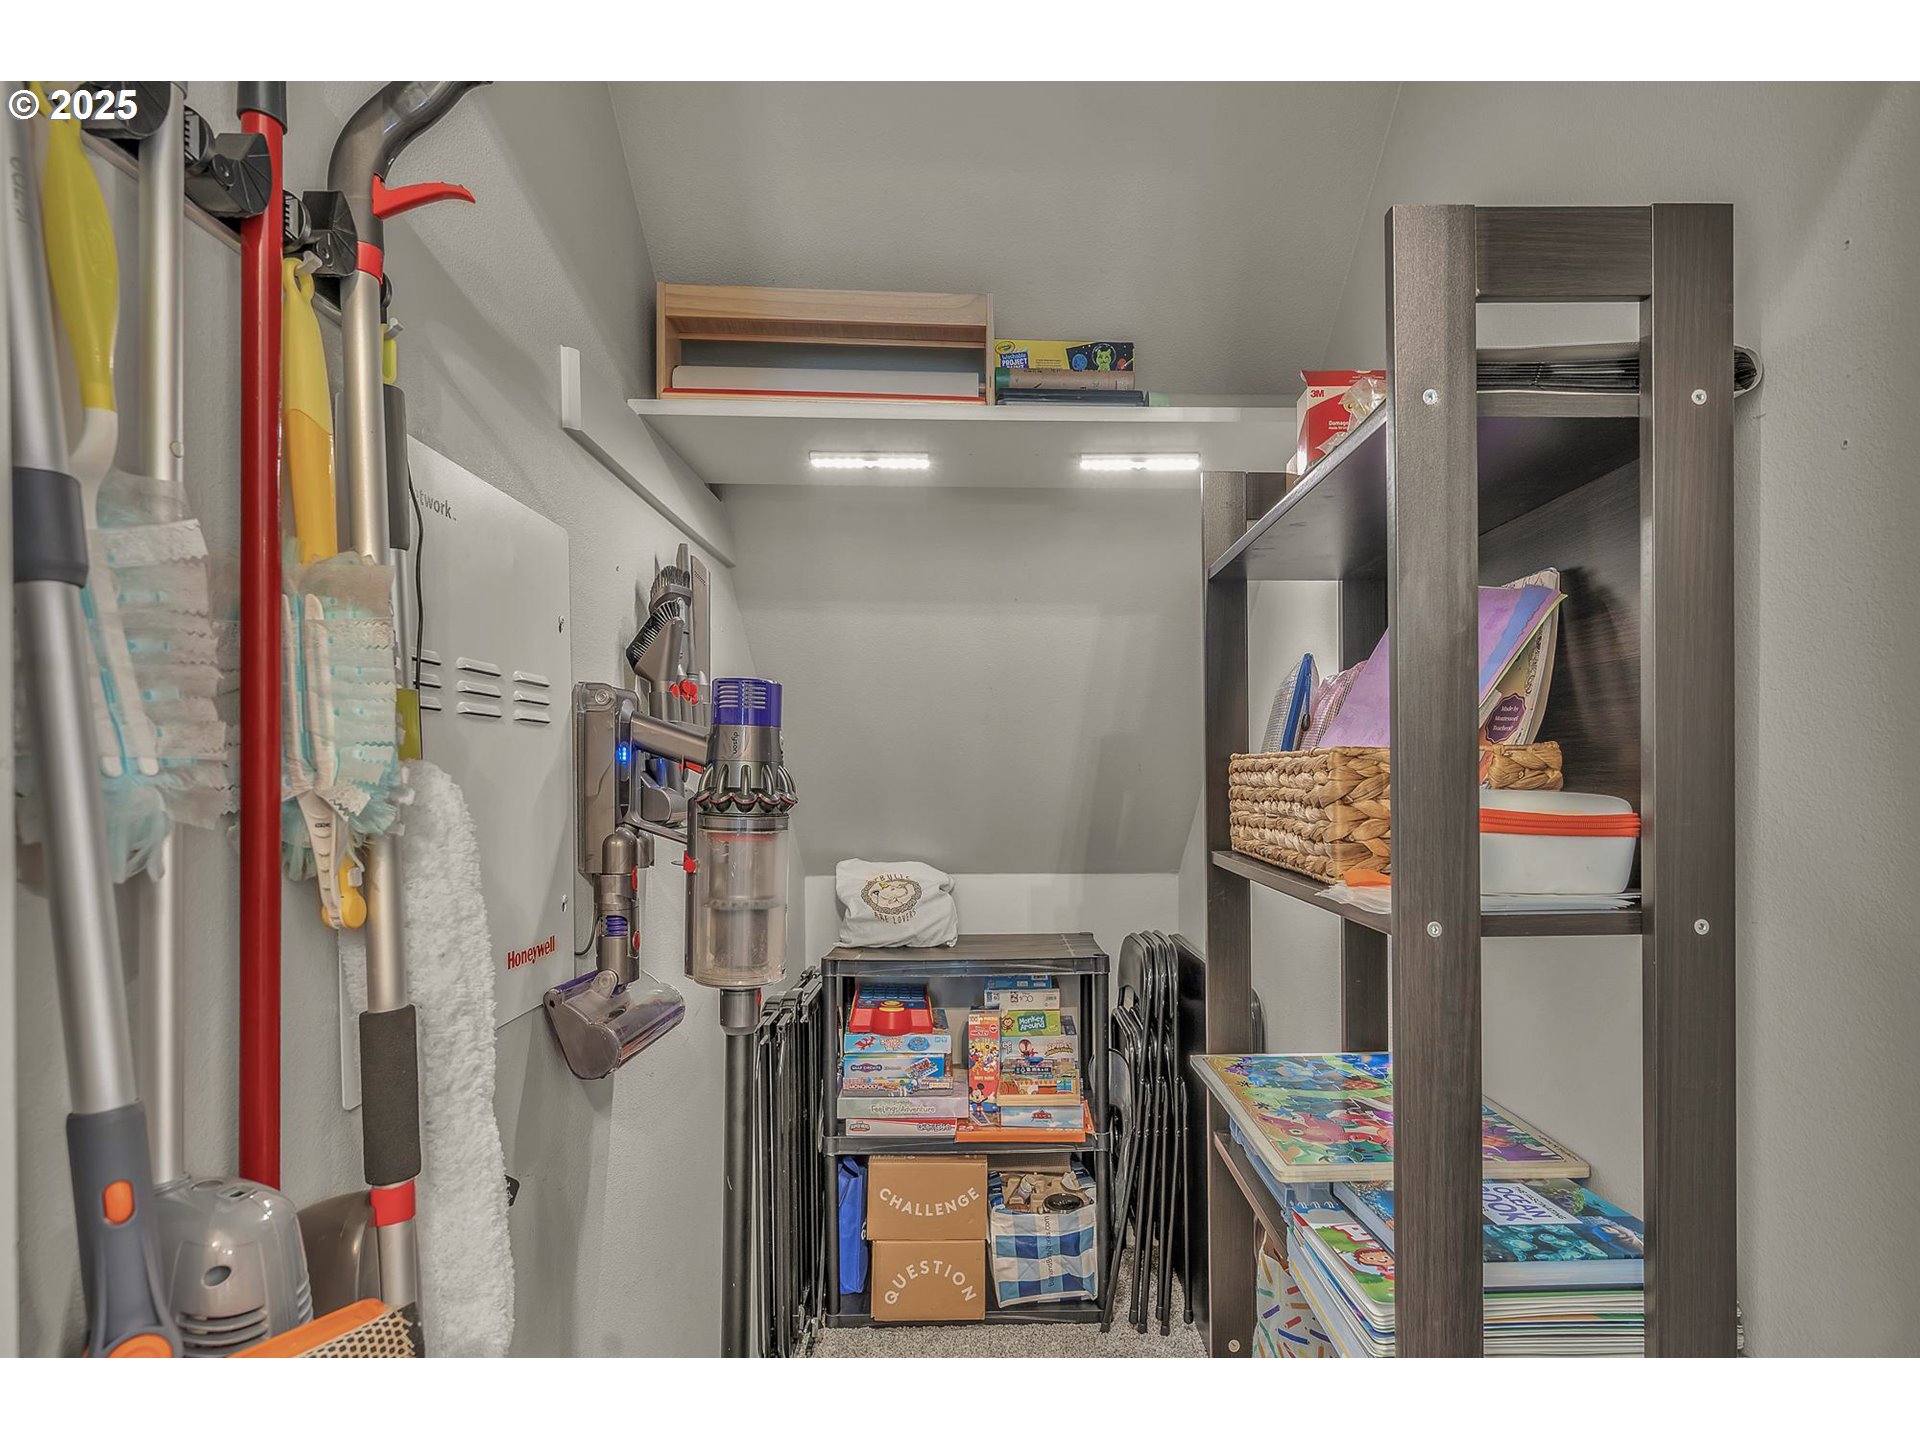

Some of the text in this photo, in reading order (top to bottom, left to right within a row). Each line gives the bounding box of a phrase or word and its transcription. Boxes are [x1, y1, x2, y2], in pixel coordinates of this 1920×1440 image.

[1001, 358, 1028, 367] PROJECT
[1310, 389, 1325, 398] 3M
[731, 731, 740, 755] dyson
[893, 909, 917, 925] LOVERS
[507, 935, 555, 970] Honeywell
[1018, 1015, 1045, 1026] Monkey
[1020, 1021, 1046, 1032] Around
[900, 1104, 936, 1113] Adventure
[880, 1187, 980, 1217] CHALLENGE
[1483, 1187, 1533, 1222] OOK
[1493, 1186, 1552, 1218] OCEAN
[885, 1260, 977, 1305] QUESTION
